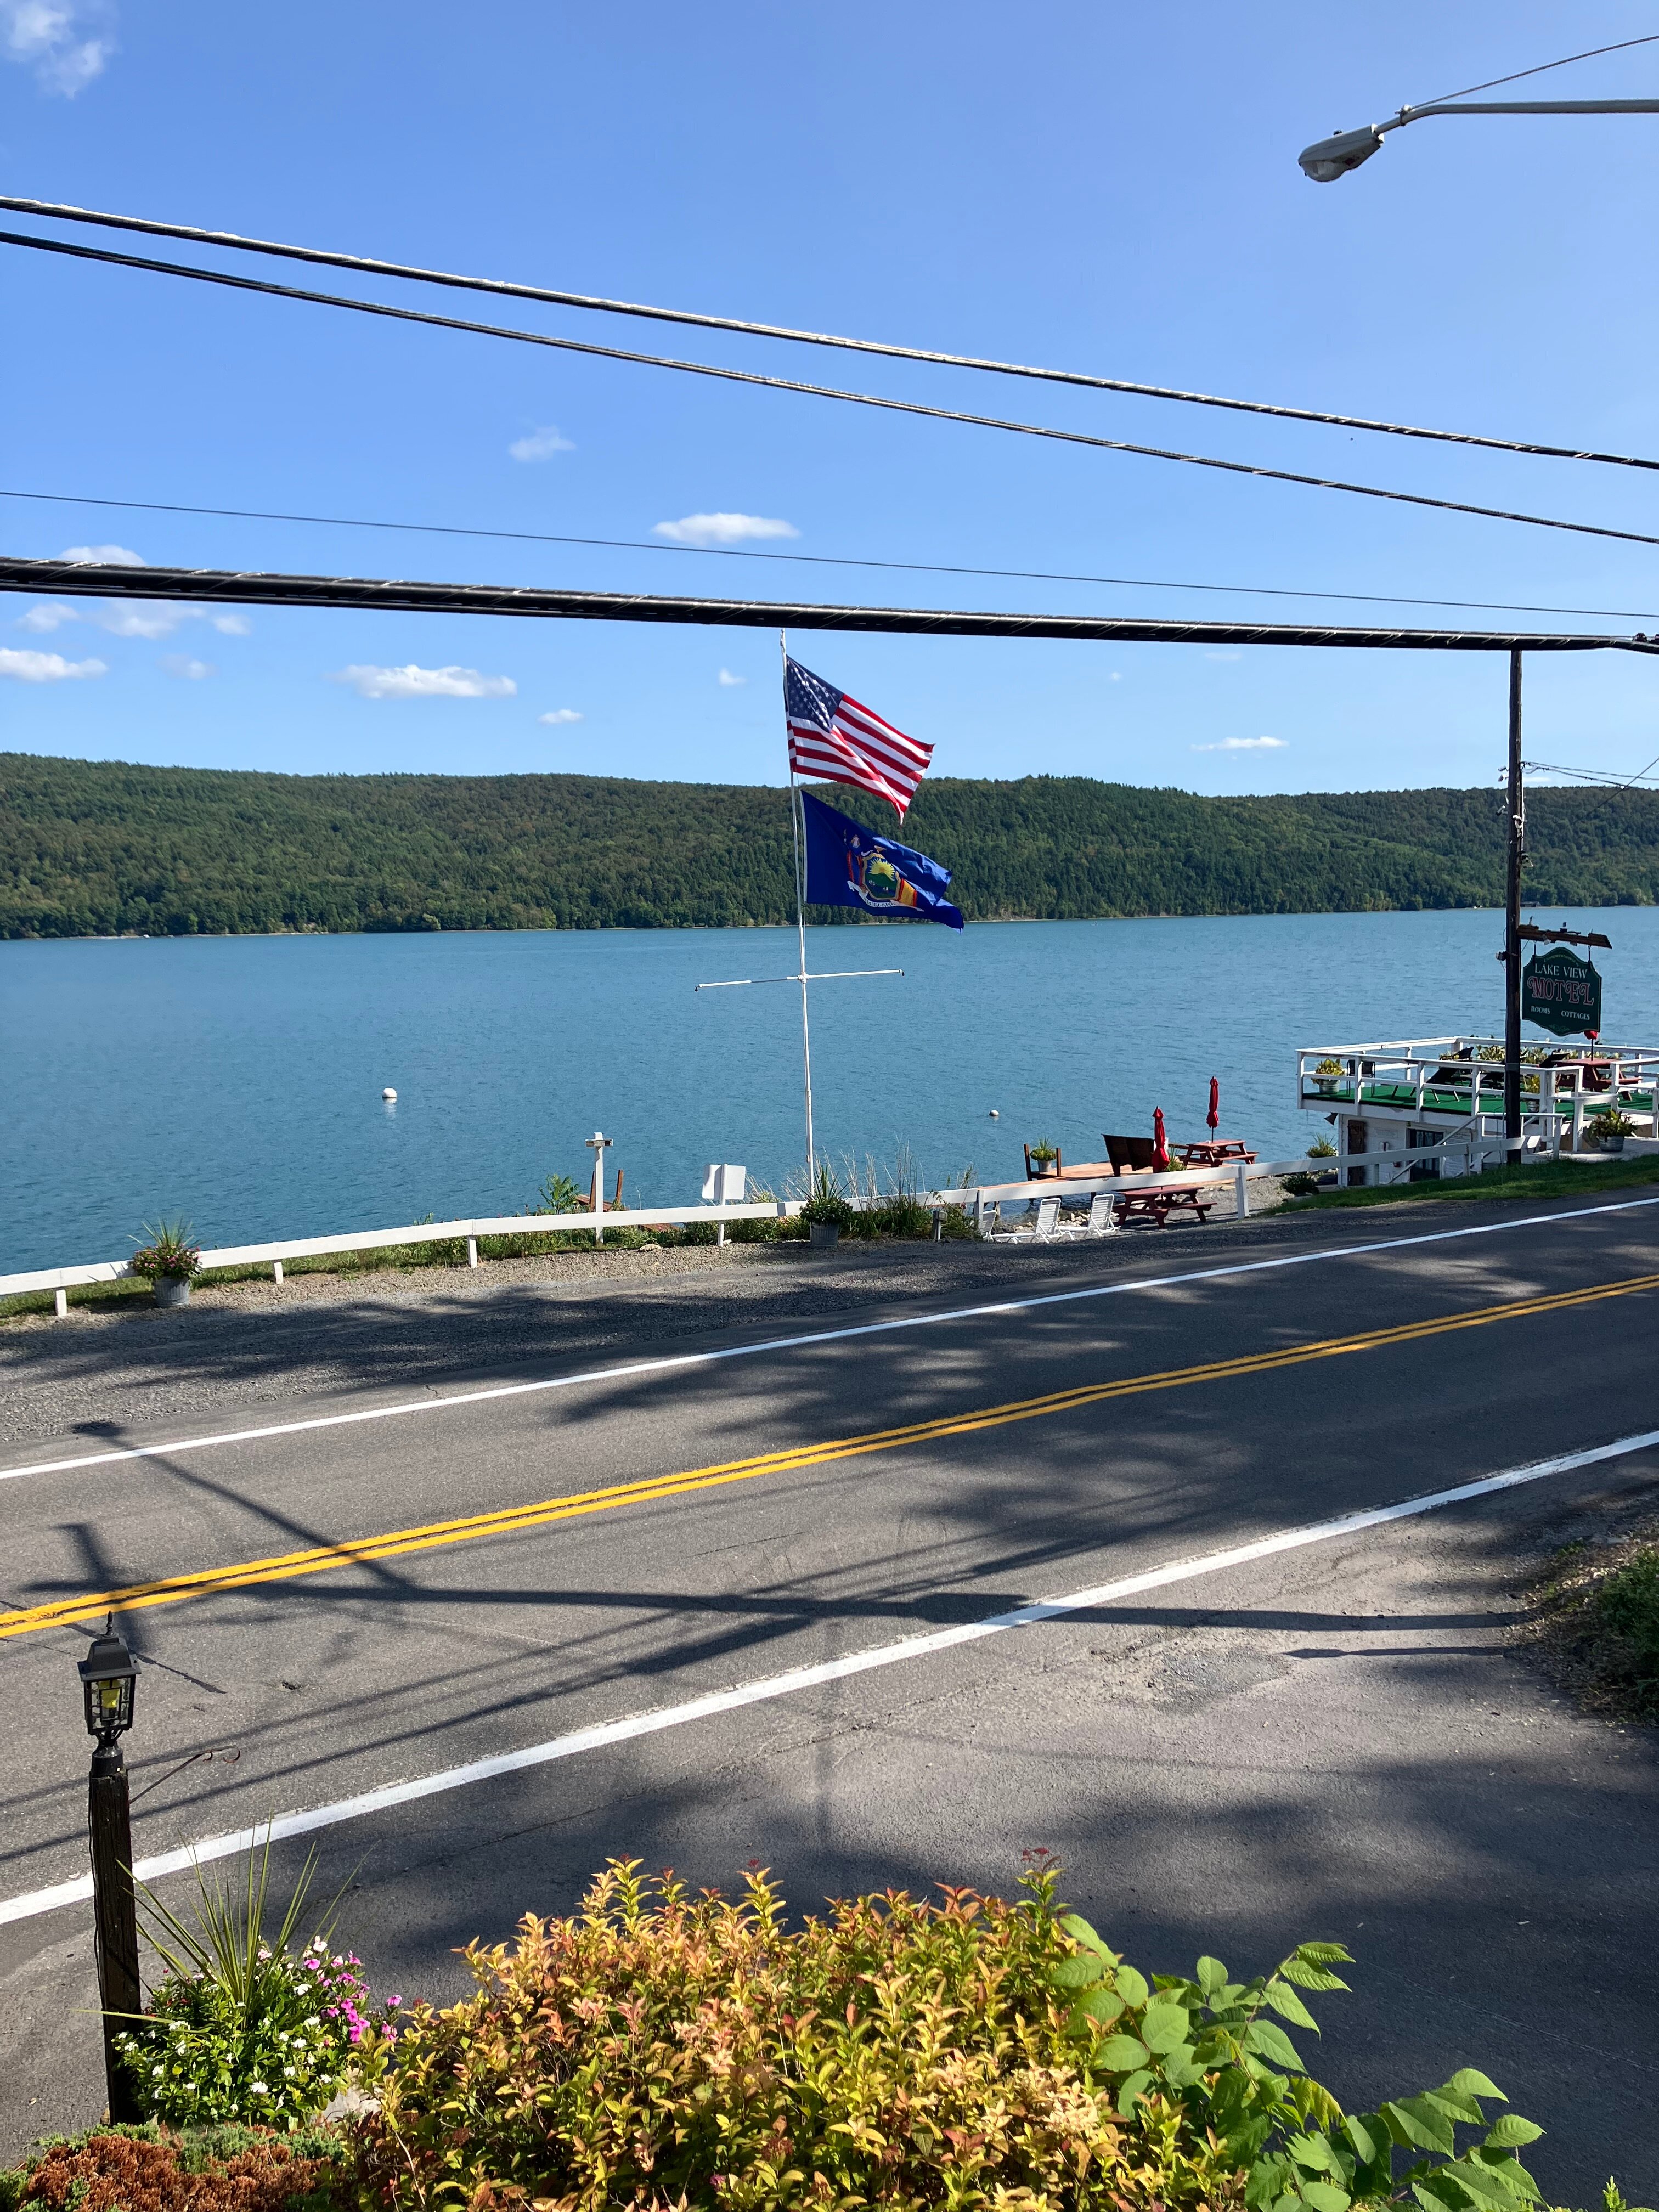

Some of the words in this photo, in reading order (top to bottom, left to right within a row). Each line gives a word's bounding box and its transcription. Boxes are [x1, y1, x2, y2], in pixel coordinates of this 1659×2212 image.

[1535, 963, 1560, 976] LAKE
[1563, 967, 1588, 979] VIEW
[1527, 976, 1594, 1006] MOTEL
[1531, 1006, 1550, 1014] ROOMS
[1561, 1010, 1590, 1020] COTTAGES
